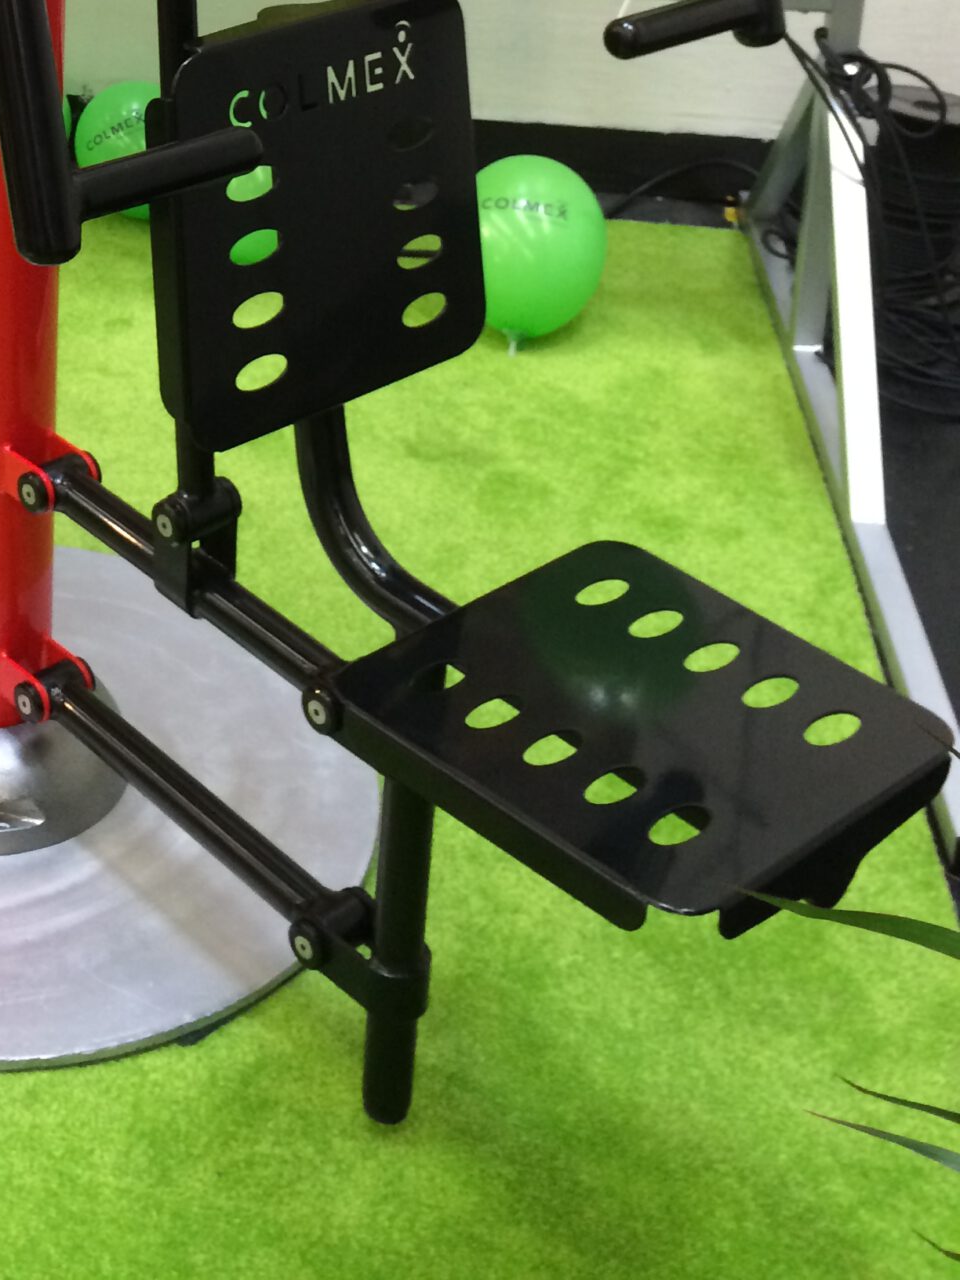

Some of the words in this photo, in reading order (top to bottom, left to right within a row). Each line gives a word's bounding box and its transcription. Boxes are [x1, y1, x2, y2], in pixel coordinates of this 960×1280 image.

[229, 41, 415, 128] COLMEX
[85, 111, 145, 152] COLMEX
[481, 196, 568, 220] COLMEX
